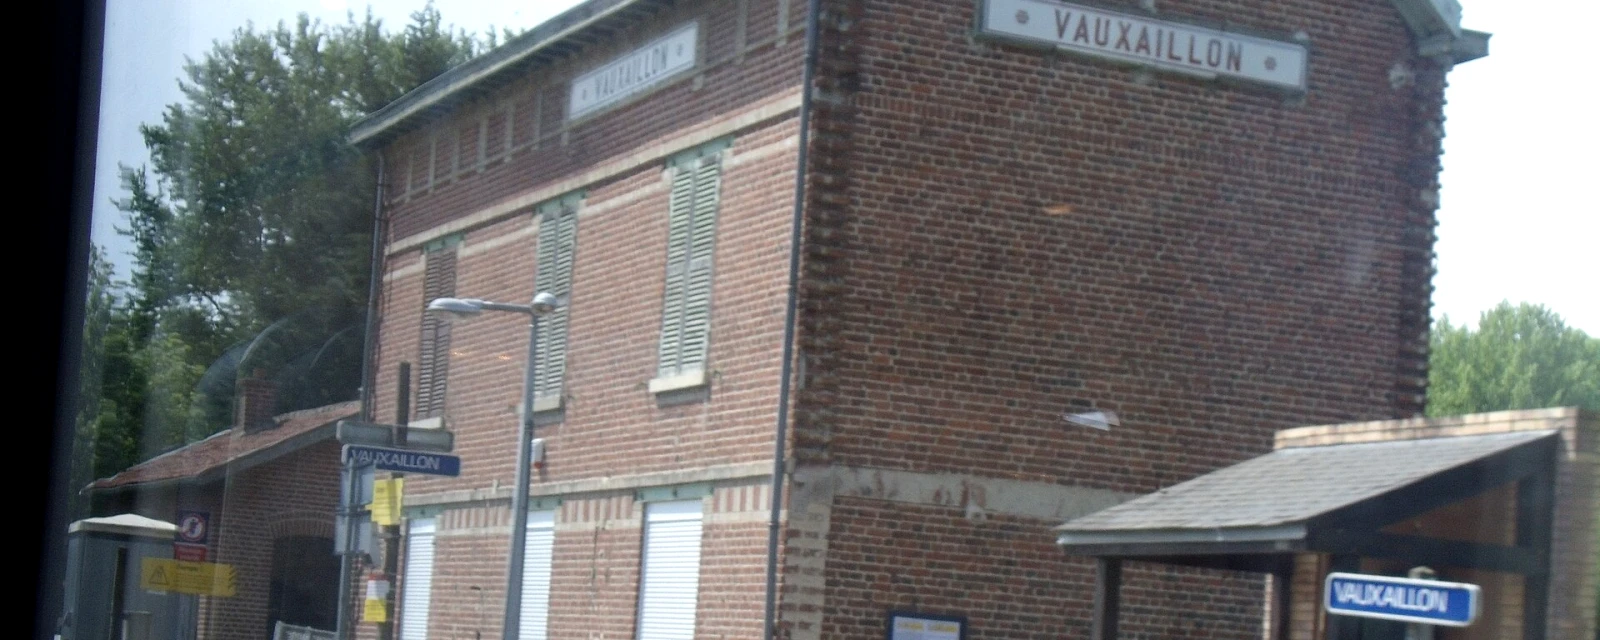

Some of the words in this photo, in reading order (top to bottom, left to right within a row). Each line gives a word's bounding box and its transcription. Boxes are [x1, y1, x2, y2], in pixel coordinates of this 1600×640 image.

[1055, 9, 1242, 71] VAUXAILLON
[594, 43, 668, 98] VAUXAILLON
[351, 449, 440, 470] VAUXAILLON
[1334, 581, 1448, 613] VAUXAILLON
